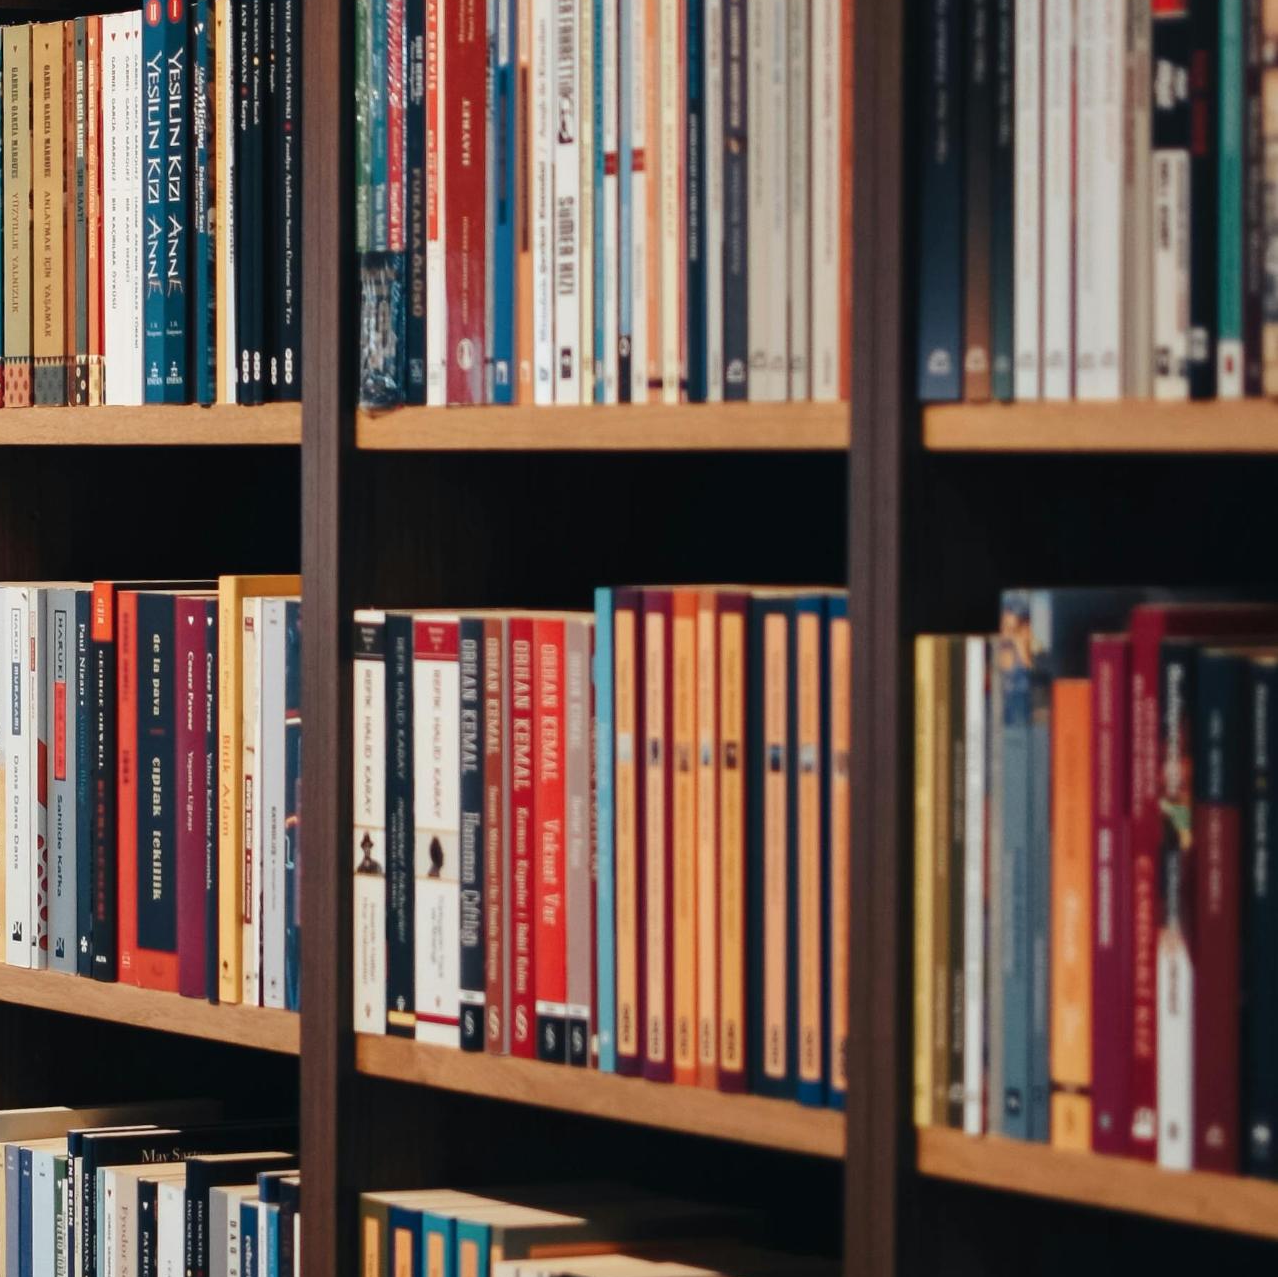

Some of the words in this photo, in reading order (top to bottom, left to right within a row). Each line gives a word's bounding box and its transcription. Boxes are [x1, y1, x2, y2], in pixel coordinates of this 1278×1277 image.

[148, 157, 161, 205] KIZI
[168, 155, 182, 204] KIZI
[147, 215, 162, 299] ANNE
[167, 213, 183, 298] ANNE
[153, 634, 161, 653] de
[153, 658, 161, 673] la
[461, 640, 477, 702] ORHAN
[486, 638, 499, 692] ORHAN
[152, 678, 160, 715] pava
[513, 641, 530, 710] ORHAN
[541, 644, 558, 708] ORHAN
[223, 734, 231, 774] Bitik
[461, 709, 477, 774] KEMAL
[486, 698, 499, 755] KEMAL
[513, 718, 530, 791] KEMAL
[541, 715, 558, 782] KEMAL
[151, 756, 162, 816] çıplak
[223, 783, 231, 837] Adam
[152, 830, 162, 900] tekillik
[542, 818, 560, 884] Vukuat
[542, 893, 559, 926] Var
[229, 1221, 237, 1255] DAG
